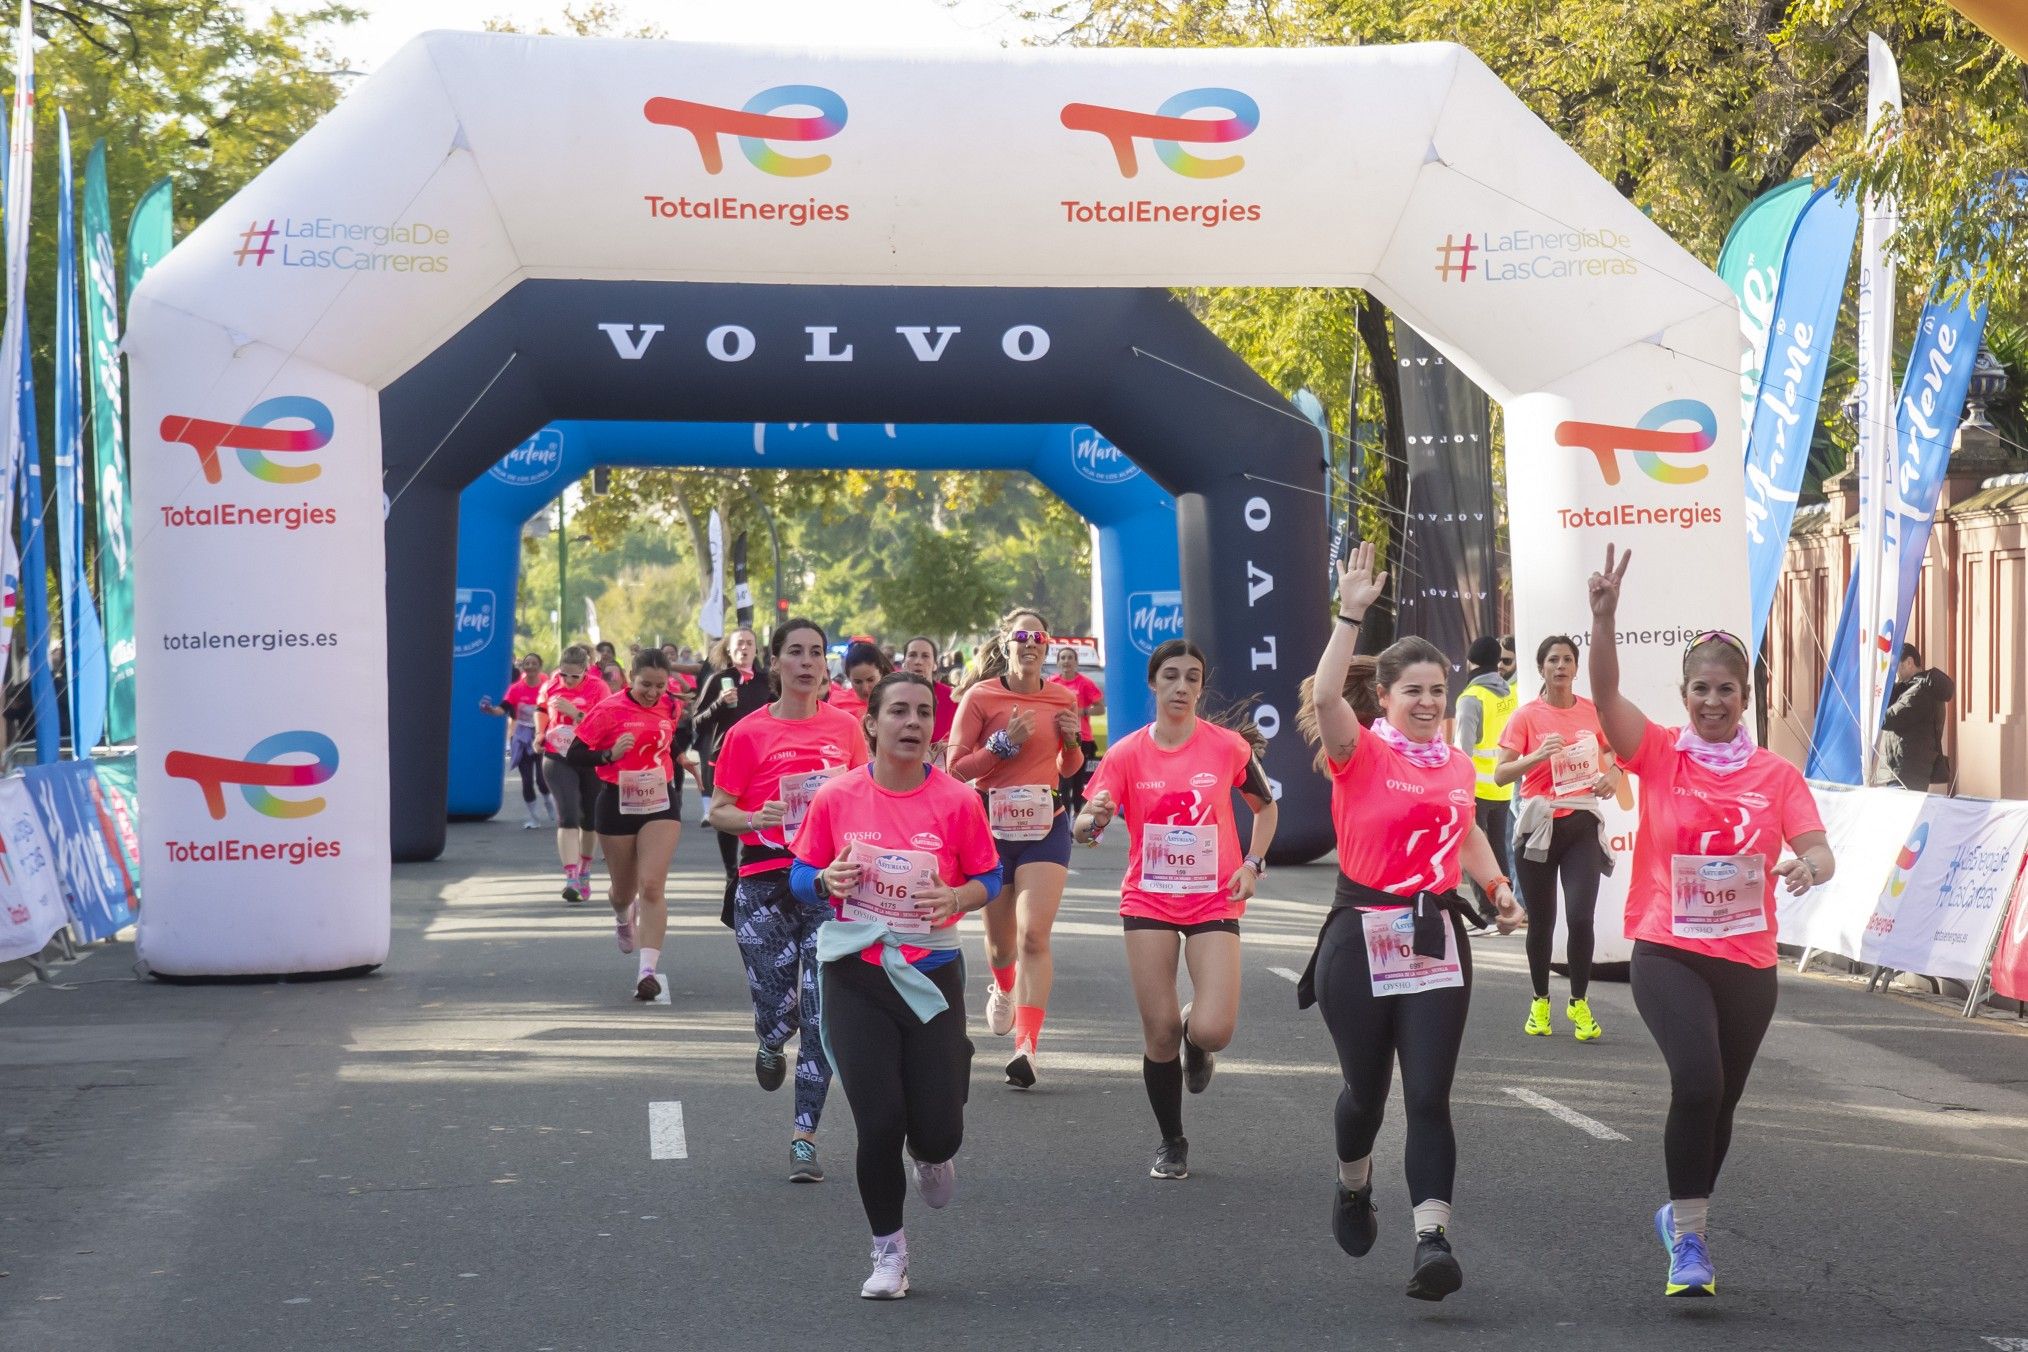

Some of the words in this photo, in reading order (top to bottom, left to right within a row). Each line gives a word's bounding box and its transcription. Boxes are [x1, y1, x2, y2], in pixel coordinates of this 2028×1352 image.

[644, 195, 850, 226] TotalEnergies
[1060, 199, 1261, 227] TotalEnergies
[282, 244, 449, 273] LasCarreras
[1485, 256, 1638, 281] LasCarreras
[598, 324, 1052, 363] VOLVO
[161, 503, 337, 530] TotalEnergies
[1557, 502, 1722, 530] TotalEnergies
[1134, 606, 1184, 640] Marle
[163, 630, 338, 652] totalenergies.es
[1570, 761, 1589, 772] 016
[637, 788, 655, 797] 016
[1136, 780, 1165, 789] OYSHO
[1386, 779, 1425, 795] OYSHO
[1011, 808, 1034, 818] 016
[843, 831, 882, 841] OYSHO
[166, 836, 342, 865] TotalEnergies
[877, 860, 910, 872] ASTURIANA
[1167, 854, 1195, 866] 016
[876, 881, 907, 898] 016
[1704, 889, 1736, 904] 016
[880, 901, 897, 909] 4175
[853, 909, 877, 923] OYSHO
[1383, 982, 1411, 990] OYSHO
